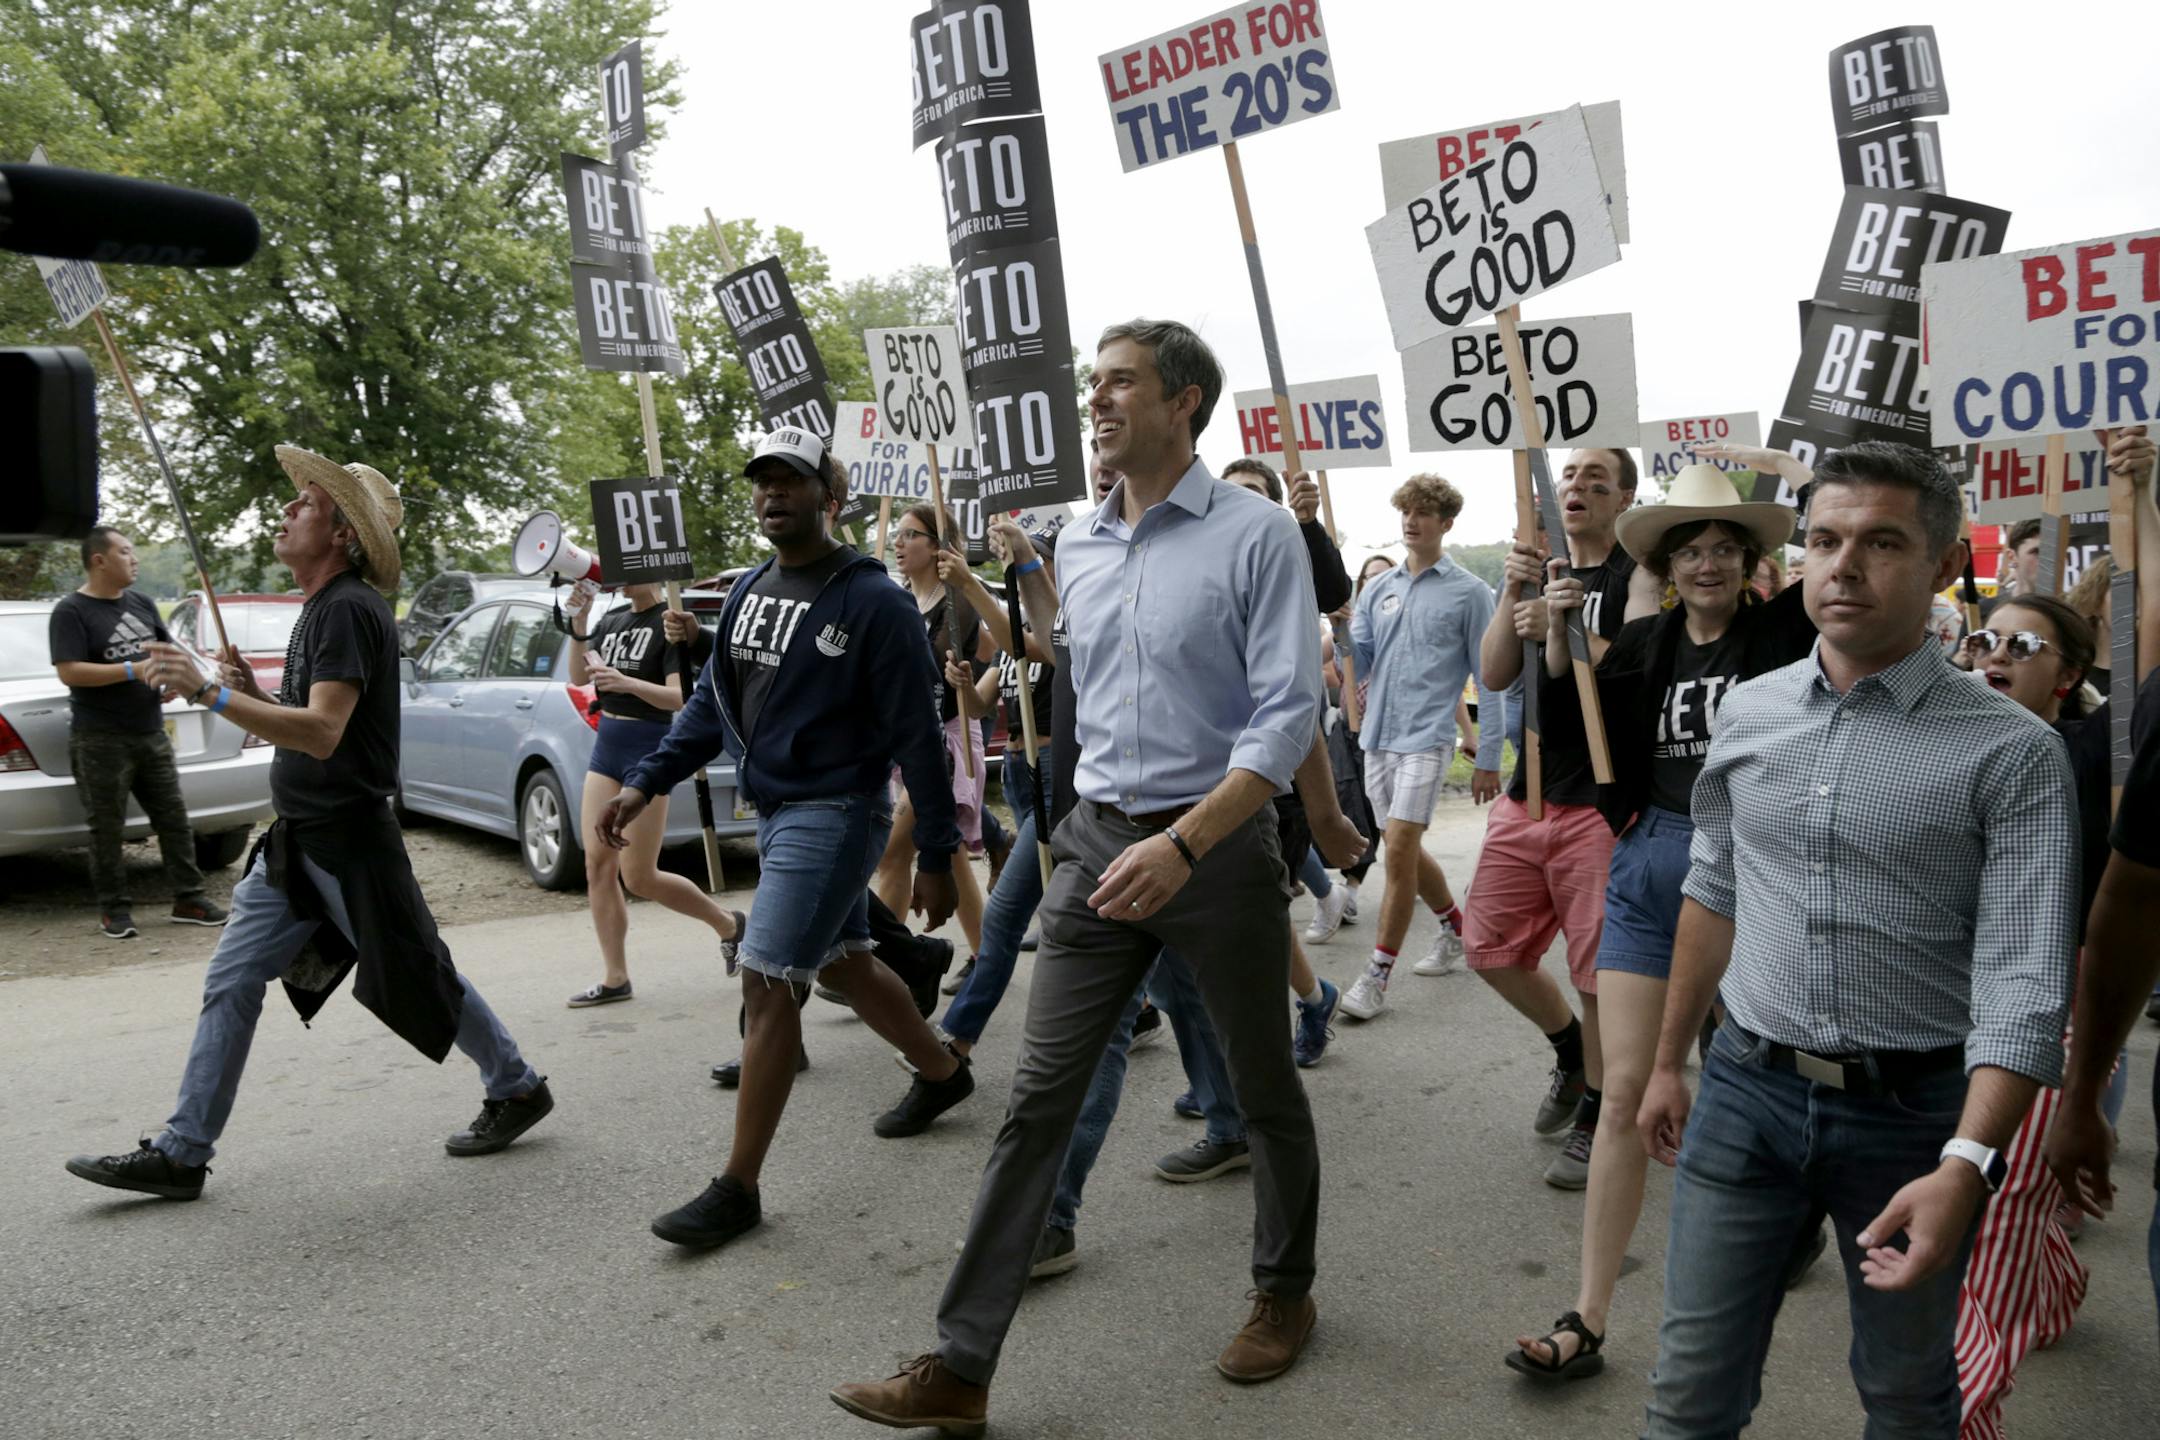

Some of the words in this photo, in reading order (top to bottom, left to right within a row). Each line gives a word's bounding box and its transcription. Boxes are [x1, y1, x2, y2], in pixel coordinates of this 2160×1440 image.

[1103, 17, 1240, 102] LEADER
[1246, 0, 1321, 56] FOR
[1843, 36, 1937, 107] BETO
[923, 104, 942, 124] FOR
[944, 84, 986, 116] AMERICA
[1117, 85, 1218, 165] THE
[1222, 48, 1332, 137] 20'S
[1869, 100, 1890, 116] FOR
[1437, 121, 1542, 182] BET
[939, 134, 1026, 226] ETO
[1408, 141, 1538, 253] BETO
[603, 236, 618, 251] FOR
[957, 214, 1002, 240] AMERICA
[1480, 201, 1509, 243] IS
[1845, 202, 1988, 279] BETO
[1425, 210, 1576, 326] GOOD
[1861, 279, 1887, 297] FOR
[2020, 236, 2160, 322] BET
[590, 277, 676, 343] BETO
[719, 269, 781, 328] BETO
[957, 261, 1041, 350] ETO
[616, 342, 632, 356] FOR
[1452, 326, 1579, 379] BETO
[2074, 310, 2160, 348] FO
[748, 333, 808, 391] BETO
[884, 333, 942, 380] BETO
[972, 342, 1017, 368] AMERICA
[884, 379, 956, 442] GOOD
[910, 375, 925, 400] IS
[1953, 355, 2160, 438] COUR
[975, 390, 1056, 478] ETO
[1667, 418, 1729, 442] BETO
[1828, 399, 1849, 417] FOR
[1851, 406, 1907, 429] AMERICA
[871, 442, 908, 460] FOR
[987, 473, 1032, 497] AMERICA
[613, 489, 687, 553] BET
[643, 553, 661, 568] FOR
[738, 646, 753, 662] FOR
[820, 622, 849, 649] BETO
[1668, 743, 1689, 758] FOR
